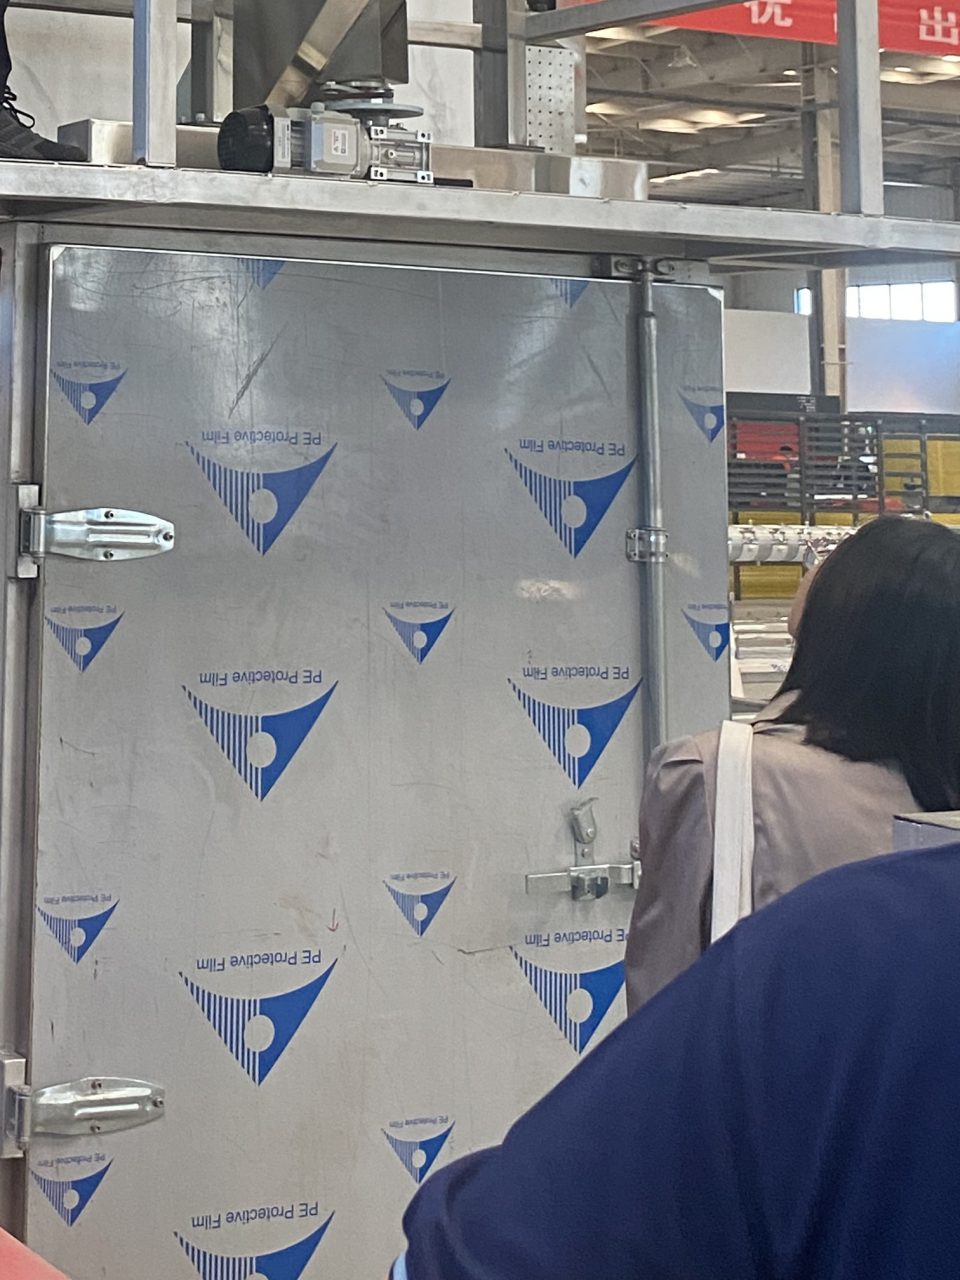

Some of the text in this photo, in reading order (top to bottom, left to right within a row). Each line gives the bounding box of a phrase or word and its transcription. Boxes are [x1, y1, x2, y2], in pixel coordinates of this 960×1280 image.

[201, 431, 322, 446] PE Protective Film
[519, 439, 626, 457] PE Protective Film
[199, 669, 323, 686] PE Protective Film
[522, 665, 630, 681] PE Protective Film
[524, 932, 550, 947] Film
[554, 929, 612, 945] Protective
[195, 949, 322, 972] PE Protective Film
[190, 1201, 320, 1231] PE Protective Film
